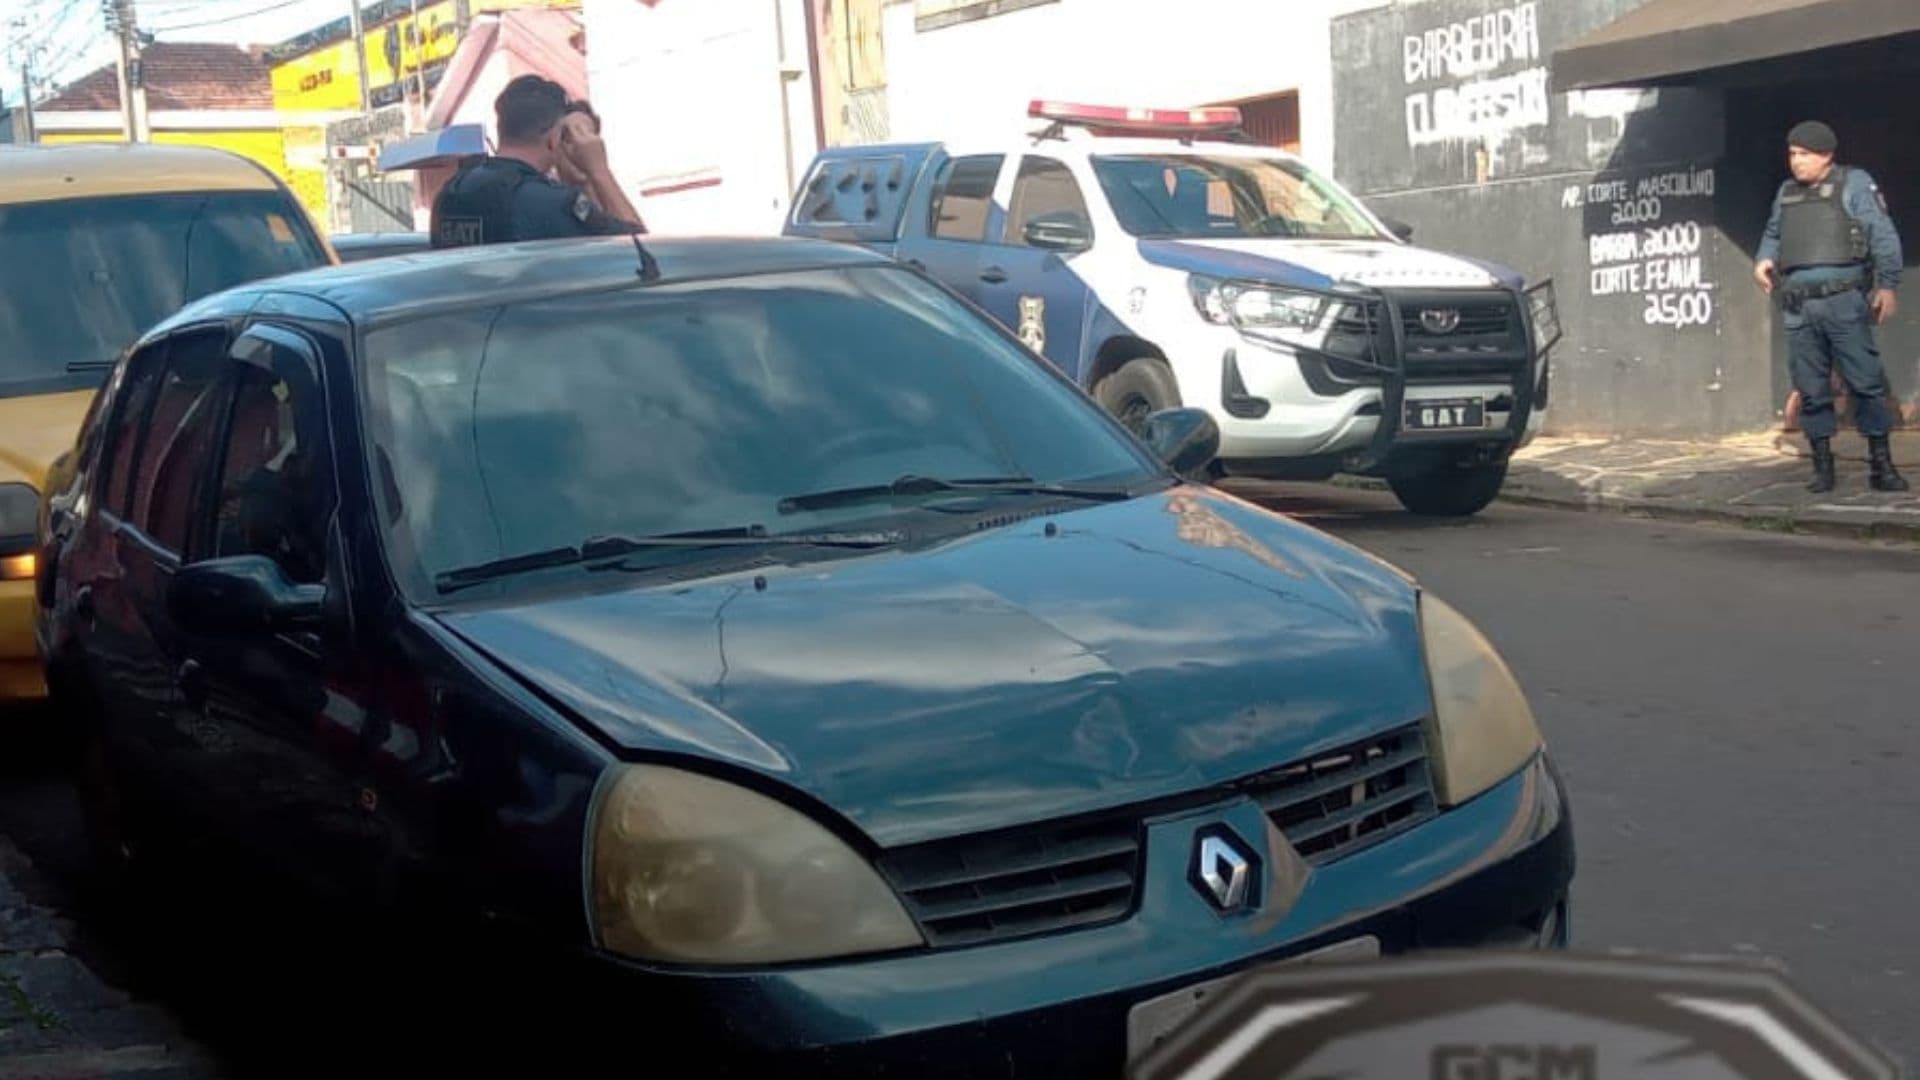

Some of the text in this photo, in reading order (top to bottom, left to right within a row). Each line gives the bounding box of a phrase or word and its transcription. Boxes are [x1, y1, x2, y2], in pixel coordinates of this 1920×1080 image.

[1403, 1, 1540, 84] BARBEARIA
[1645, 291, 1711, 329] 25,00
[1421, 407, 1467, 426] GAT
